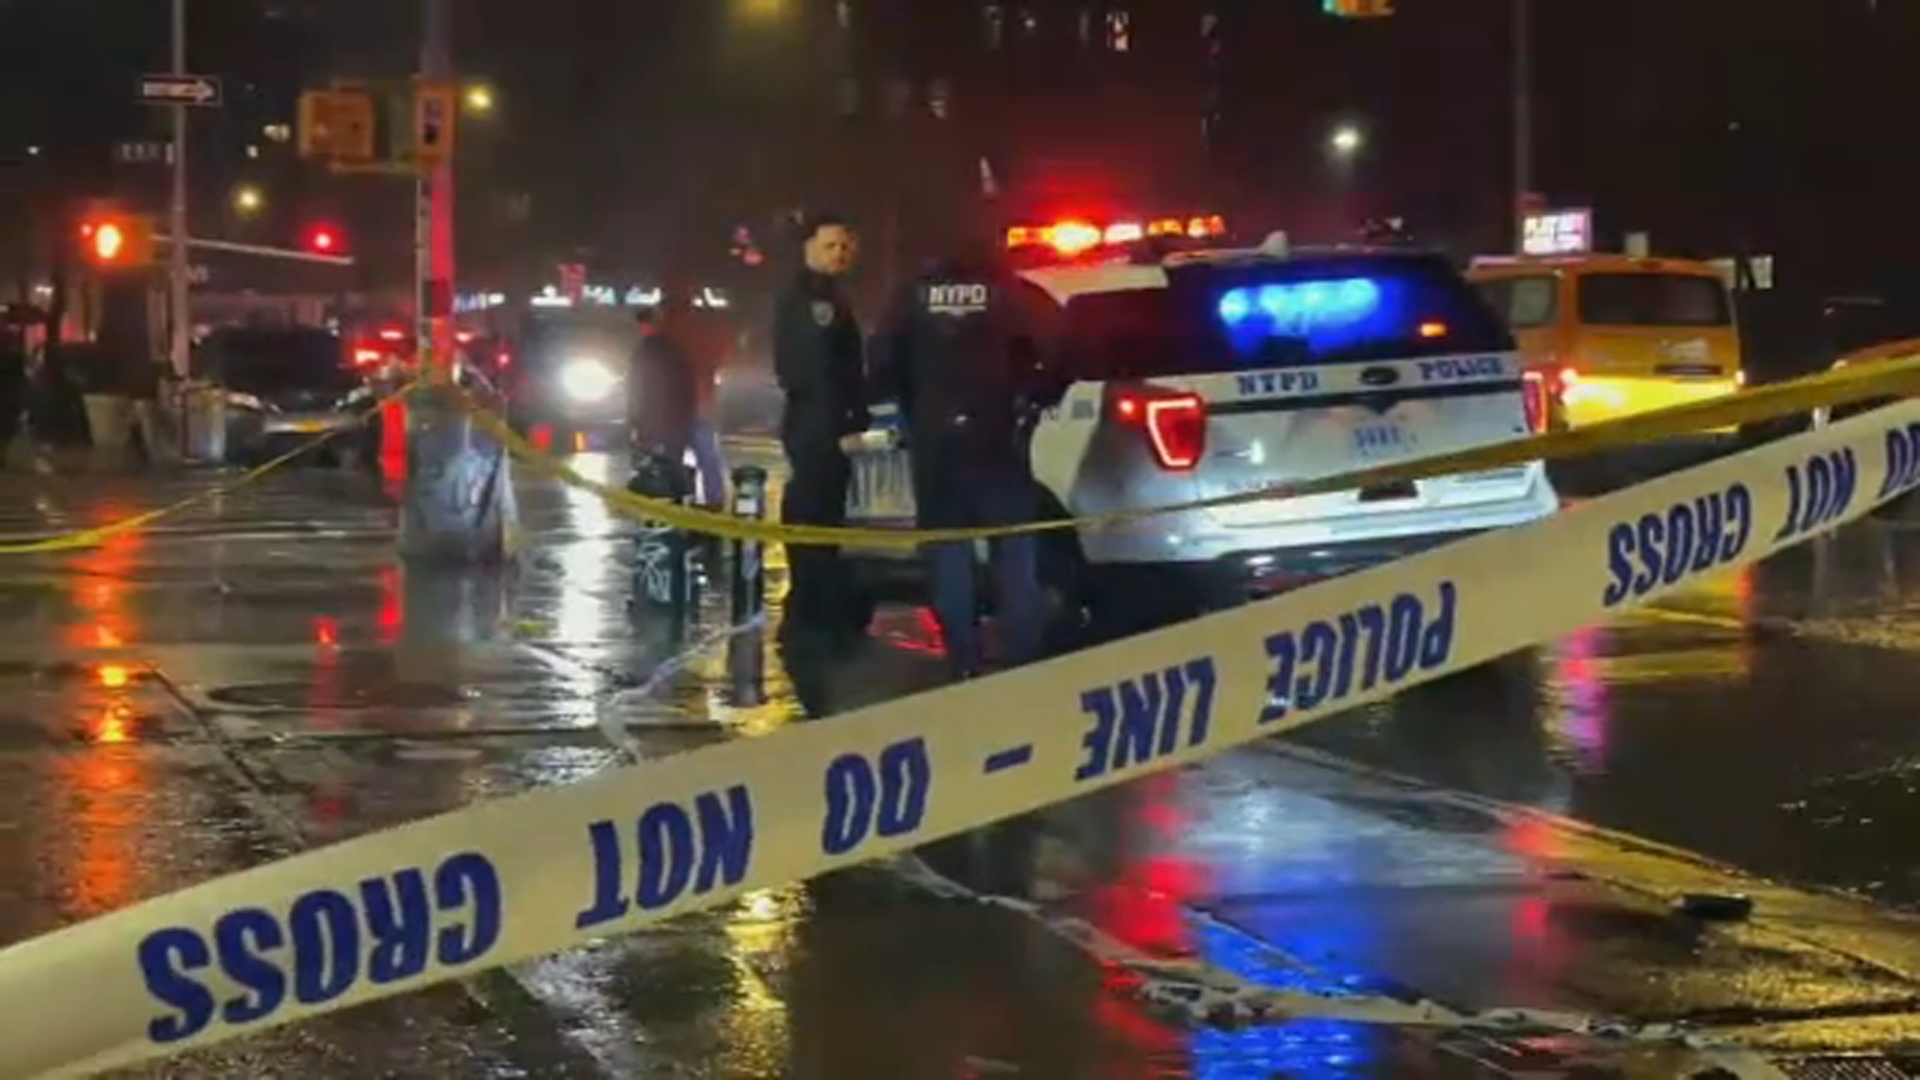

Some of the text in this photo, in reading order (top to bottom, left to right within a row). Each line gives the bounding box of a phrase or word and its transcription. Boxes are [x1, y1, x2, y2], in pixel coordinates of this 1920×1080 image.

[928, 283, 988, 305] NYPD
[1236, 356, 1504, 396] NYPD POLICE
[1604, 481, 1753, 607] CROSS
[1772, 444, 1857, 544] NOT
[1257, 580, 1457, 725] POLICE
[1074, 655, 1216, 780] LINE
[575, 784, 754, 930] NOT
[822, 736, 931, 855] DO
[137, 851, 502, 1045] CROSS
